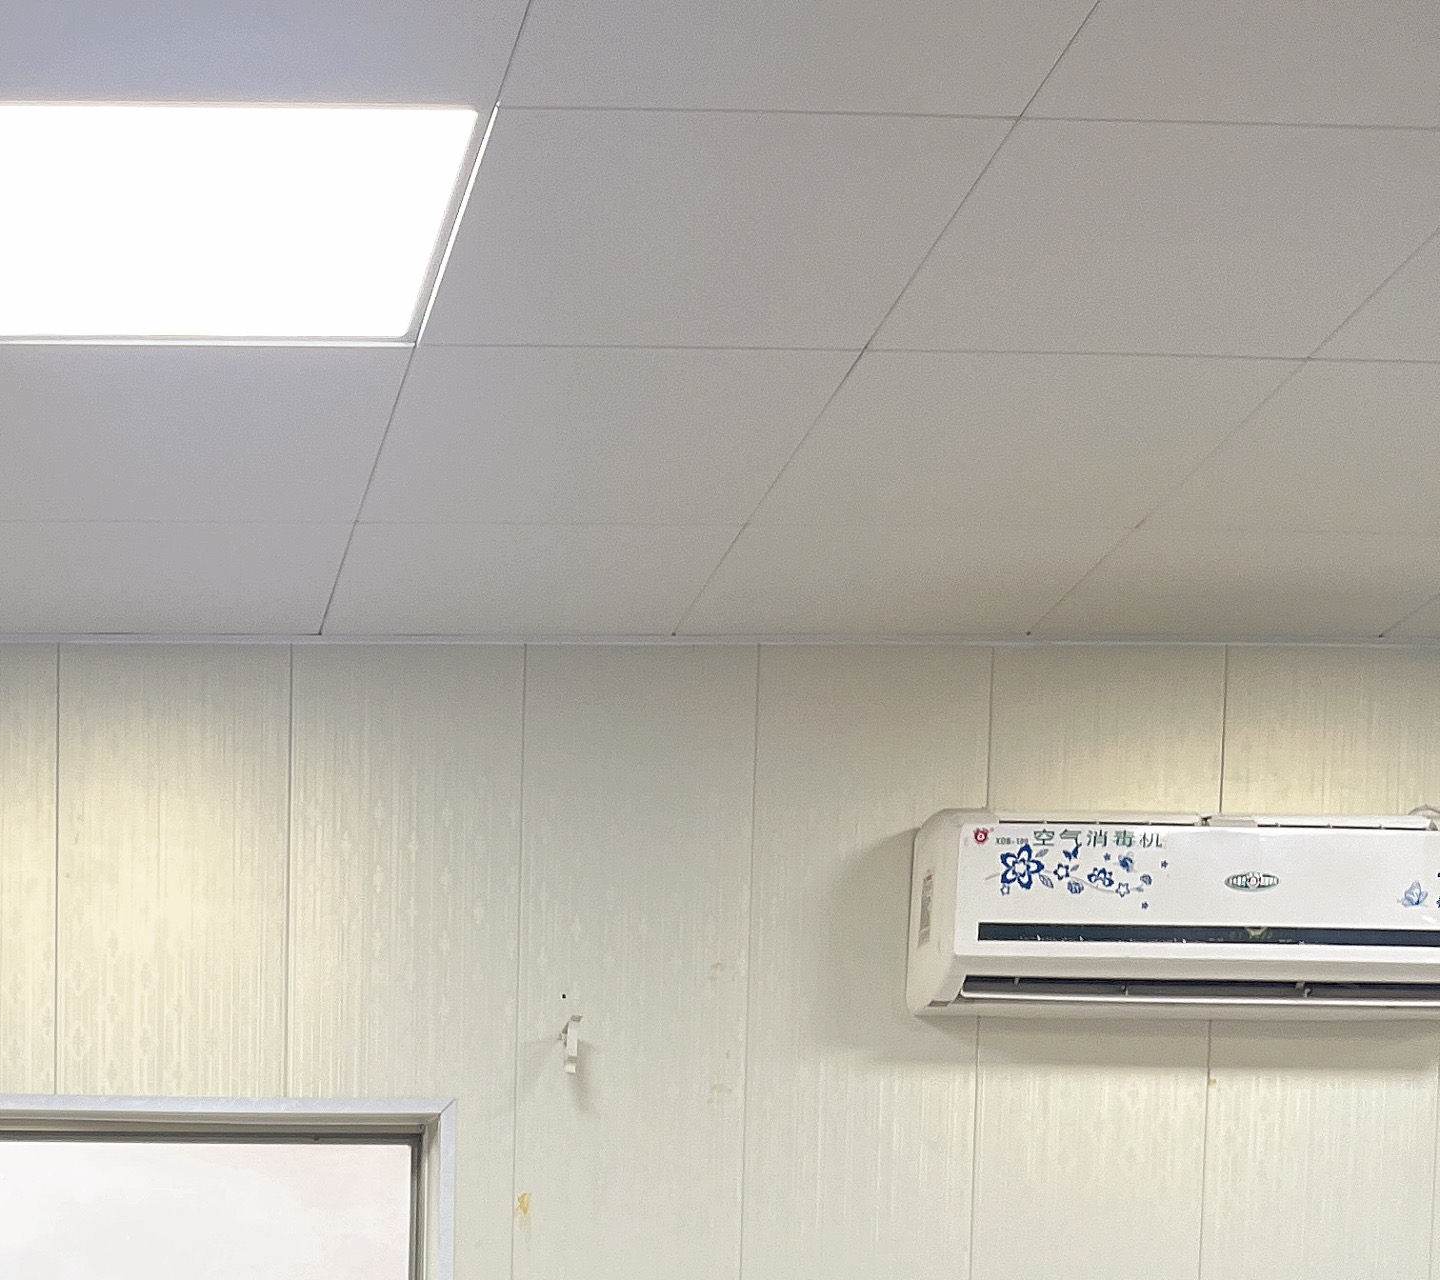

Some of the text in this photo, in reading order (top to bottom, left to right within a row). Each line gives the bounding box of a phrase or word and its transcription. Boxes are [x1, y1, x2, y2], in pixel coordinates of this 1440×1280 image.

[1033, 829, 1162, 848] 空气消毒机
